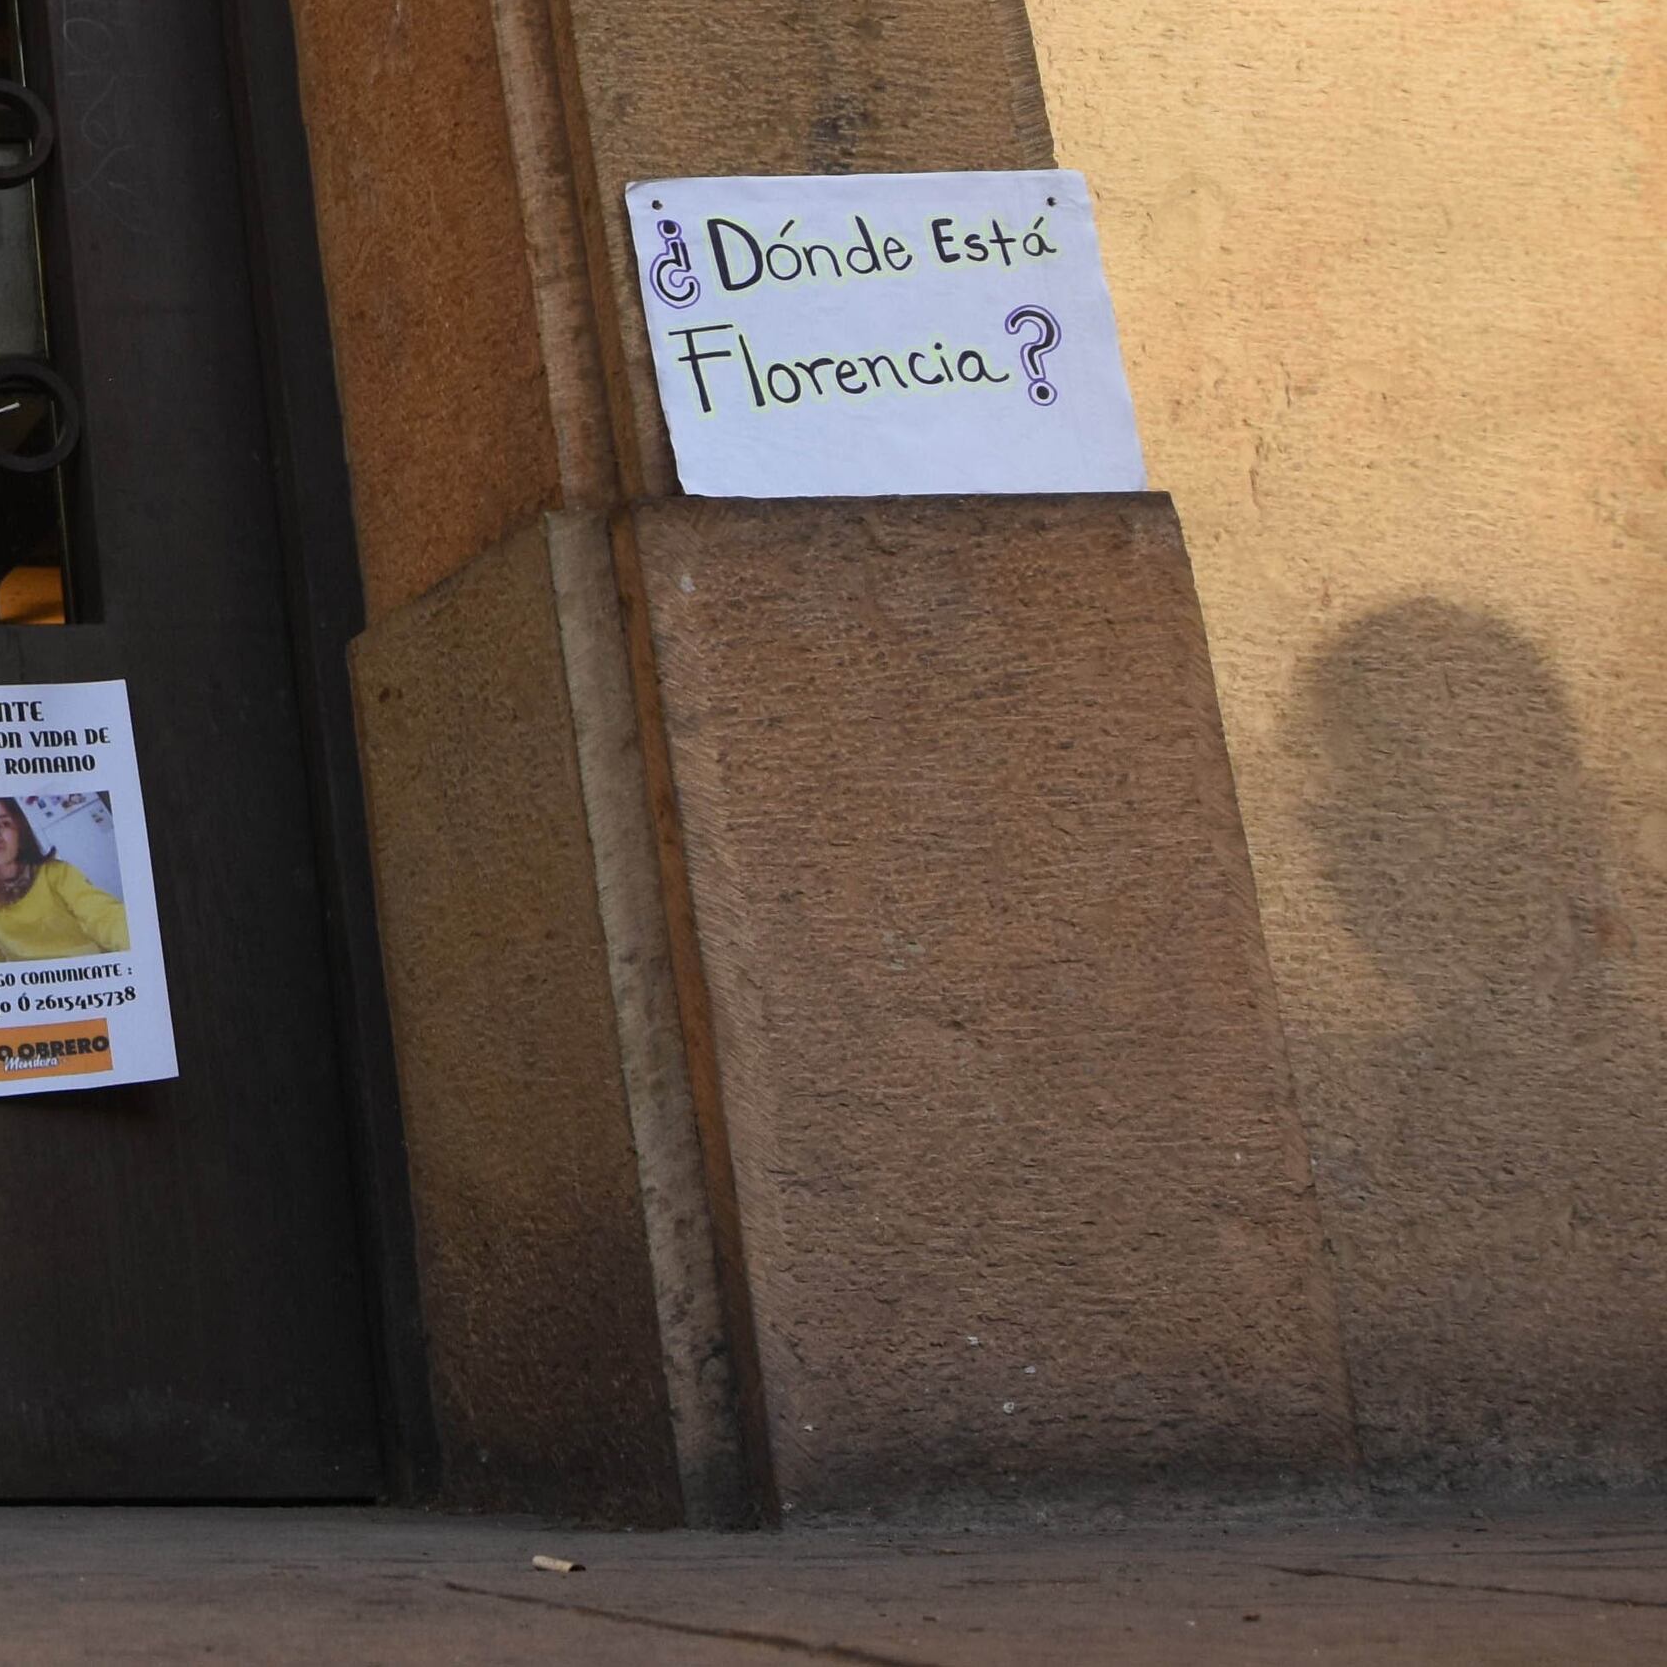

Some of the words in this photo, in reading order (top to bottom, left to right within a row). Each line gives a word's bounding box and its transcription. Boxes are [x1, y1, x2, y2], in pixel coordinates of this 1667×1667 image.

[932, 216, 1058, 267] Está
[29, 730, 77, 747] VIDA
[85, 727, 110, 745] DE
[4, 755, 95, 774] ROMANO
[18, 1036, 109, 1058] OBRERO
